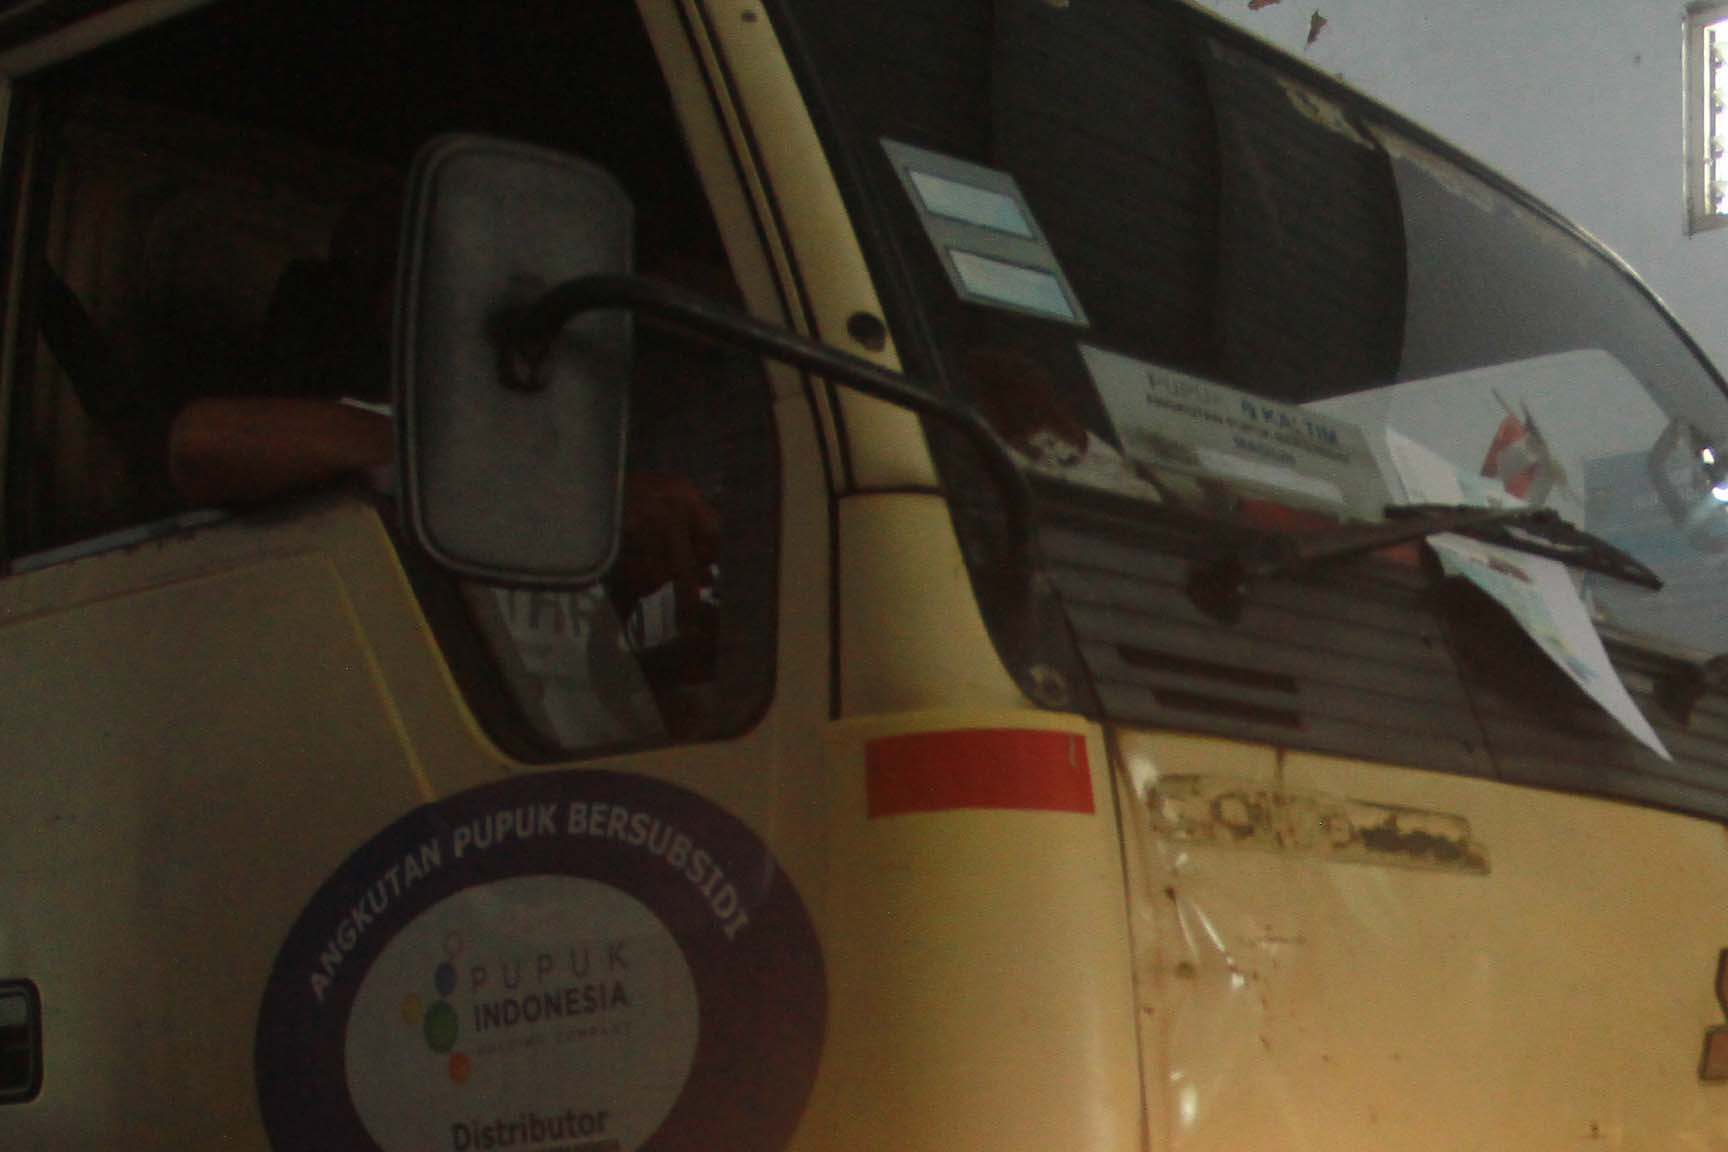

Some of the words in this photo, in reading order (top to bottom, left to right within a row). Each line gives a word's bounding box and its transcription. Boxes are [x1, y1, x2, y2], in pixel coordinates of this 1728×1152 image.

[310, 843, 442, 1000] ANGKUTAN
[453, 803, 559, 857] PUPUK
[567, 802, 751, 939] BERSUBSIDI
[470, 943, 629, 994] PUPUK
[473, 982, 629, 1032] INDONESIA
